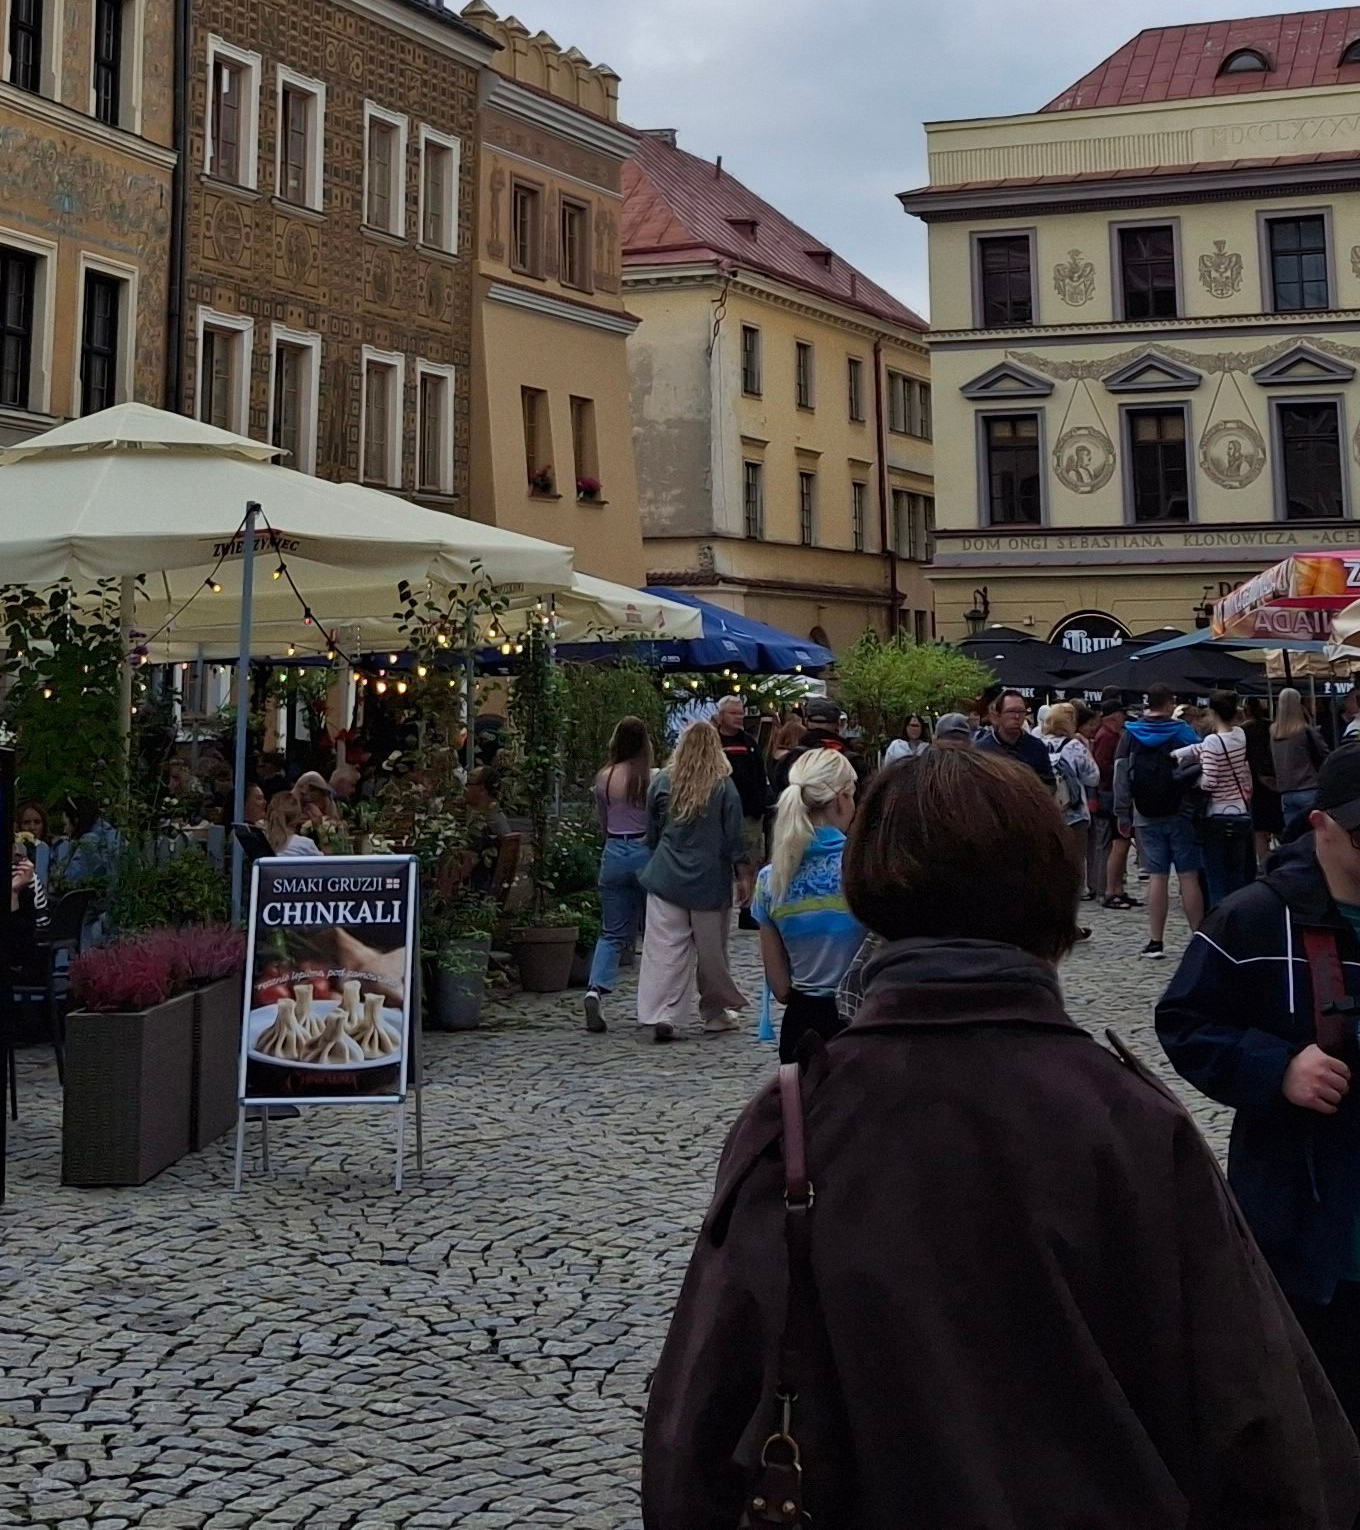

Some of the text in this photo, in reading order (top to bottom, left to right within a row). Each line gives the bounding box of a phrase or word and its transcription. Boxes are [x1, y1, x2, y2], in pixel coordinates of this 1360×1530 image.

[213, 537, 300, 557] ZWIEZYNIEC
[962, 538, 1000, 551] DOM
[1008, 537, 1048, 550] ONGI
[1057, 535, 1163, 549] SEBASTIANA
[1183, 532, 1297, 547] KLONOWICZA
[273, 877, 382, 893] SMAKI GRUZJI
[263, 900, 401, 925] CHINKALI
